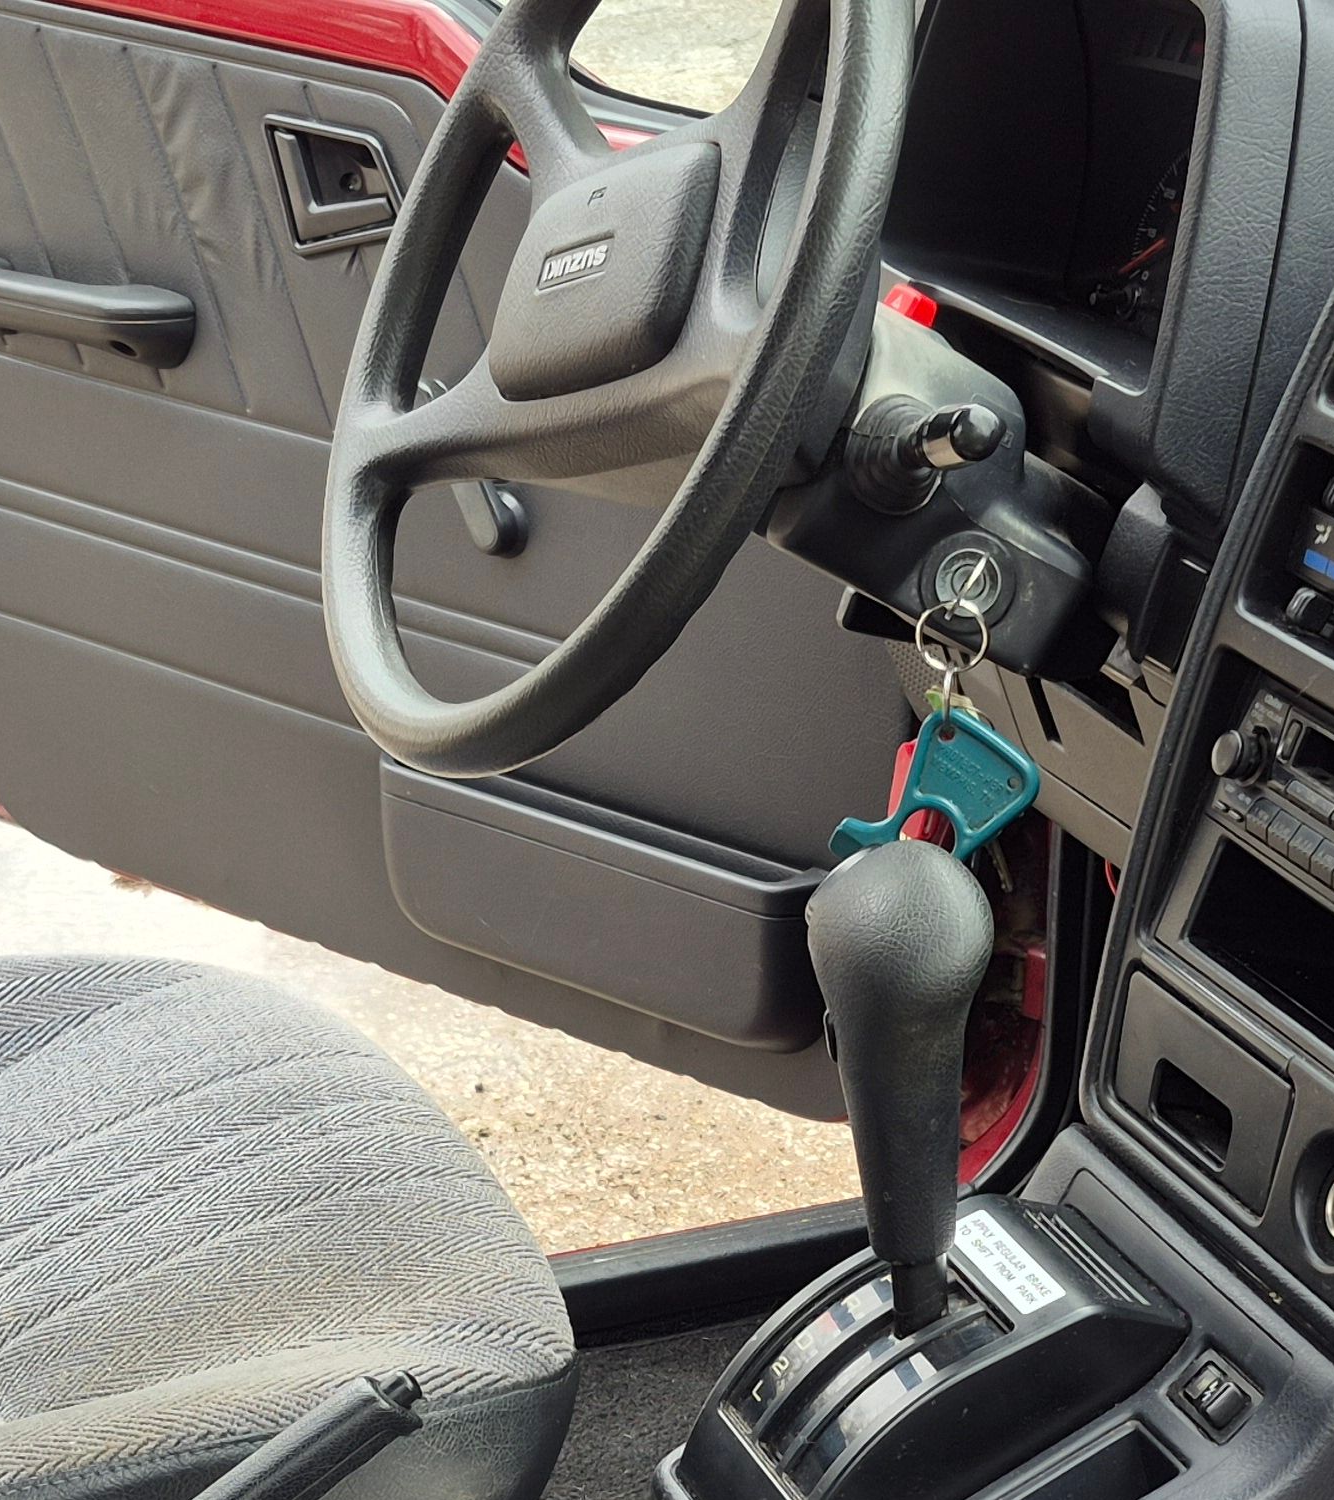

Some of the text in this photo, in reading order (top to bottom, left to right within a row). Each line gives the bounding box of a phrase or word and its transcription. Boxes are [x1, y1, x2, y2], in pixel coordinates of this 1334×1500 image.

[542, 245, 608, 282] SUZUKI
[959, 1224, 1038, 1305] TO SHIFT FROM PARK
[971, 1218, 1052, 1298] APPLY REGULAR BRAKE
[771, 1356, 790, 1377] 2
[751, 1379, 764, 1402] L
